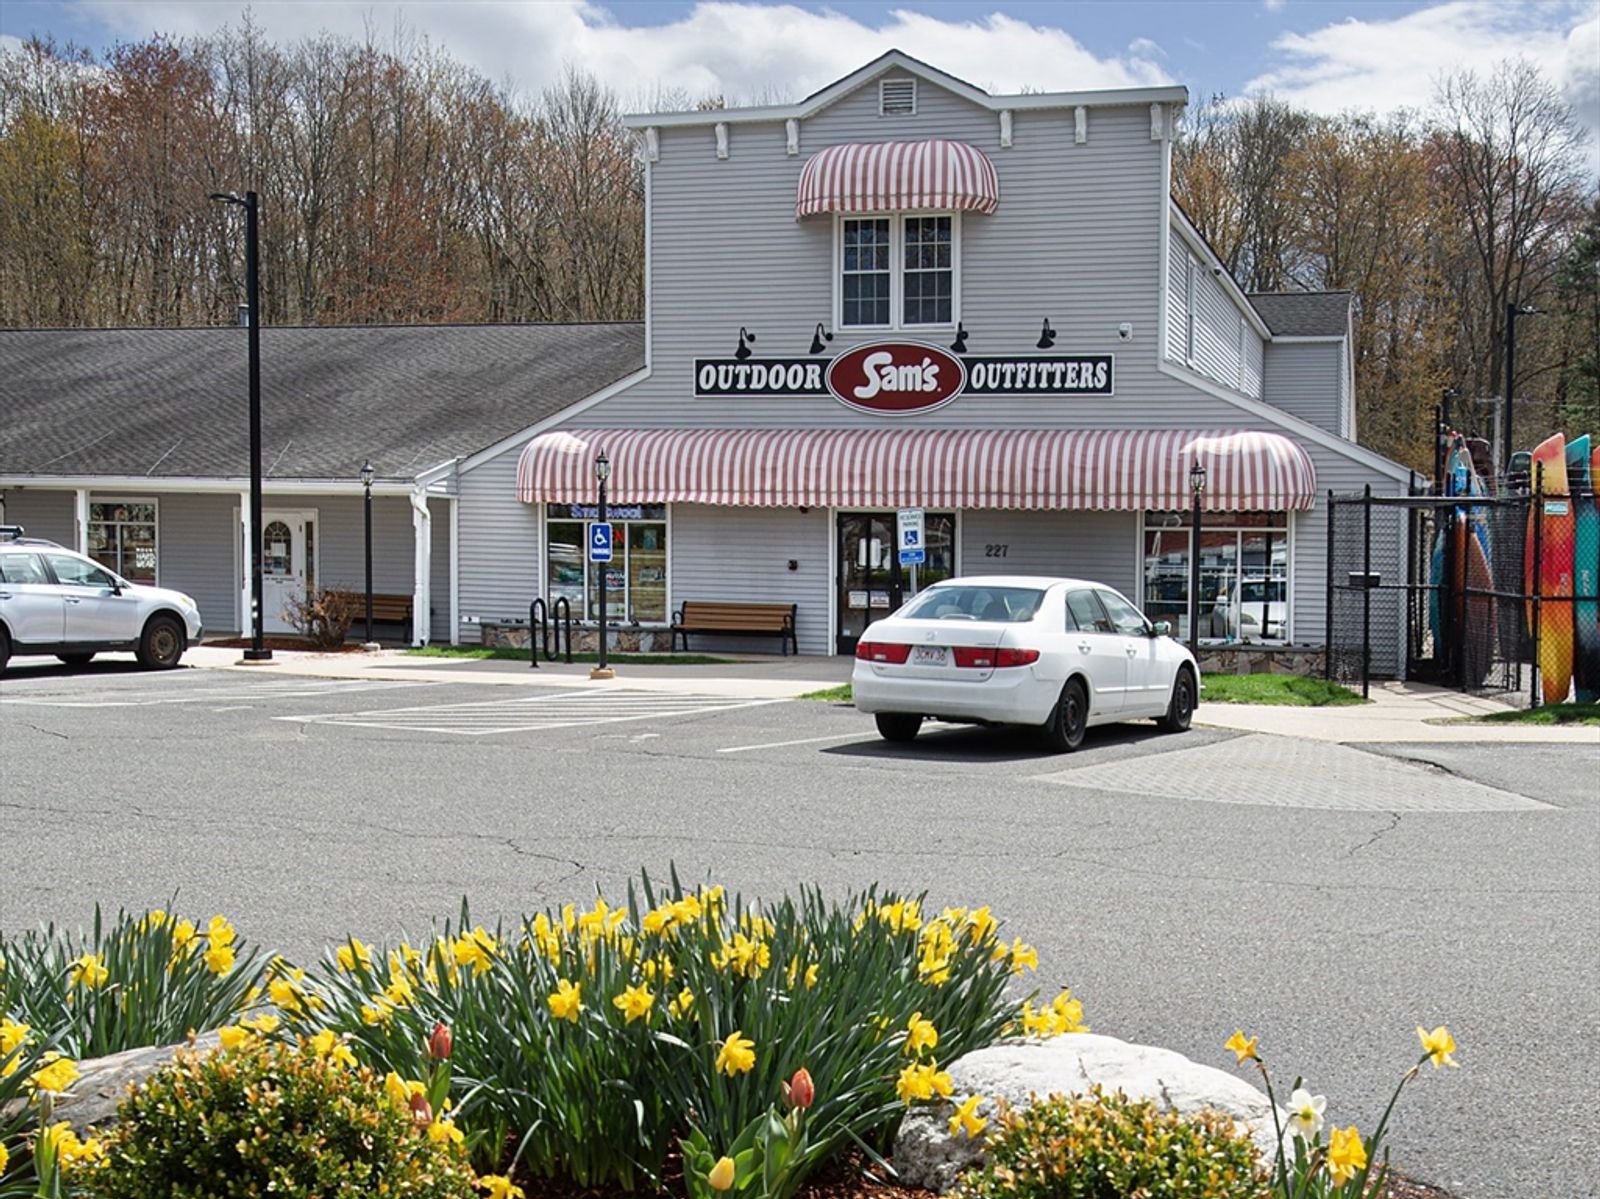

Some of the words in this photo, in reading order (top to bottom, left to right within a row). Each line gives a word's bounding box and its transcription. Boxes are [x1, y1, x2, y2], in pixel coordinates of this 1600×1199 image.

[699, 363, 821, 390] OUTDOOR
[853, 351, 941, 398] Sam's
[970, 361, 1107, 389] OUTFITTERS
[985, 544, 1008, 557] 227
